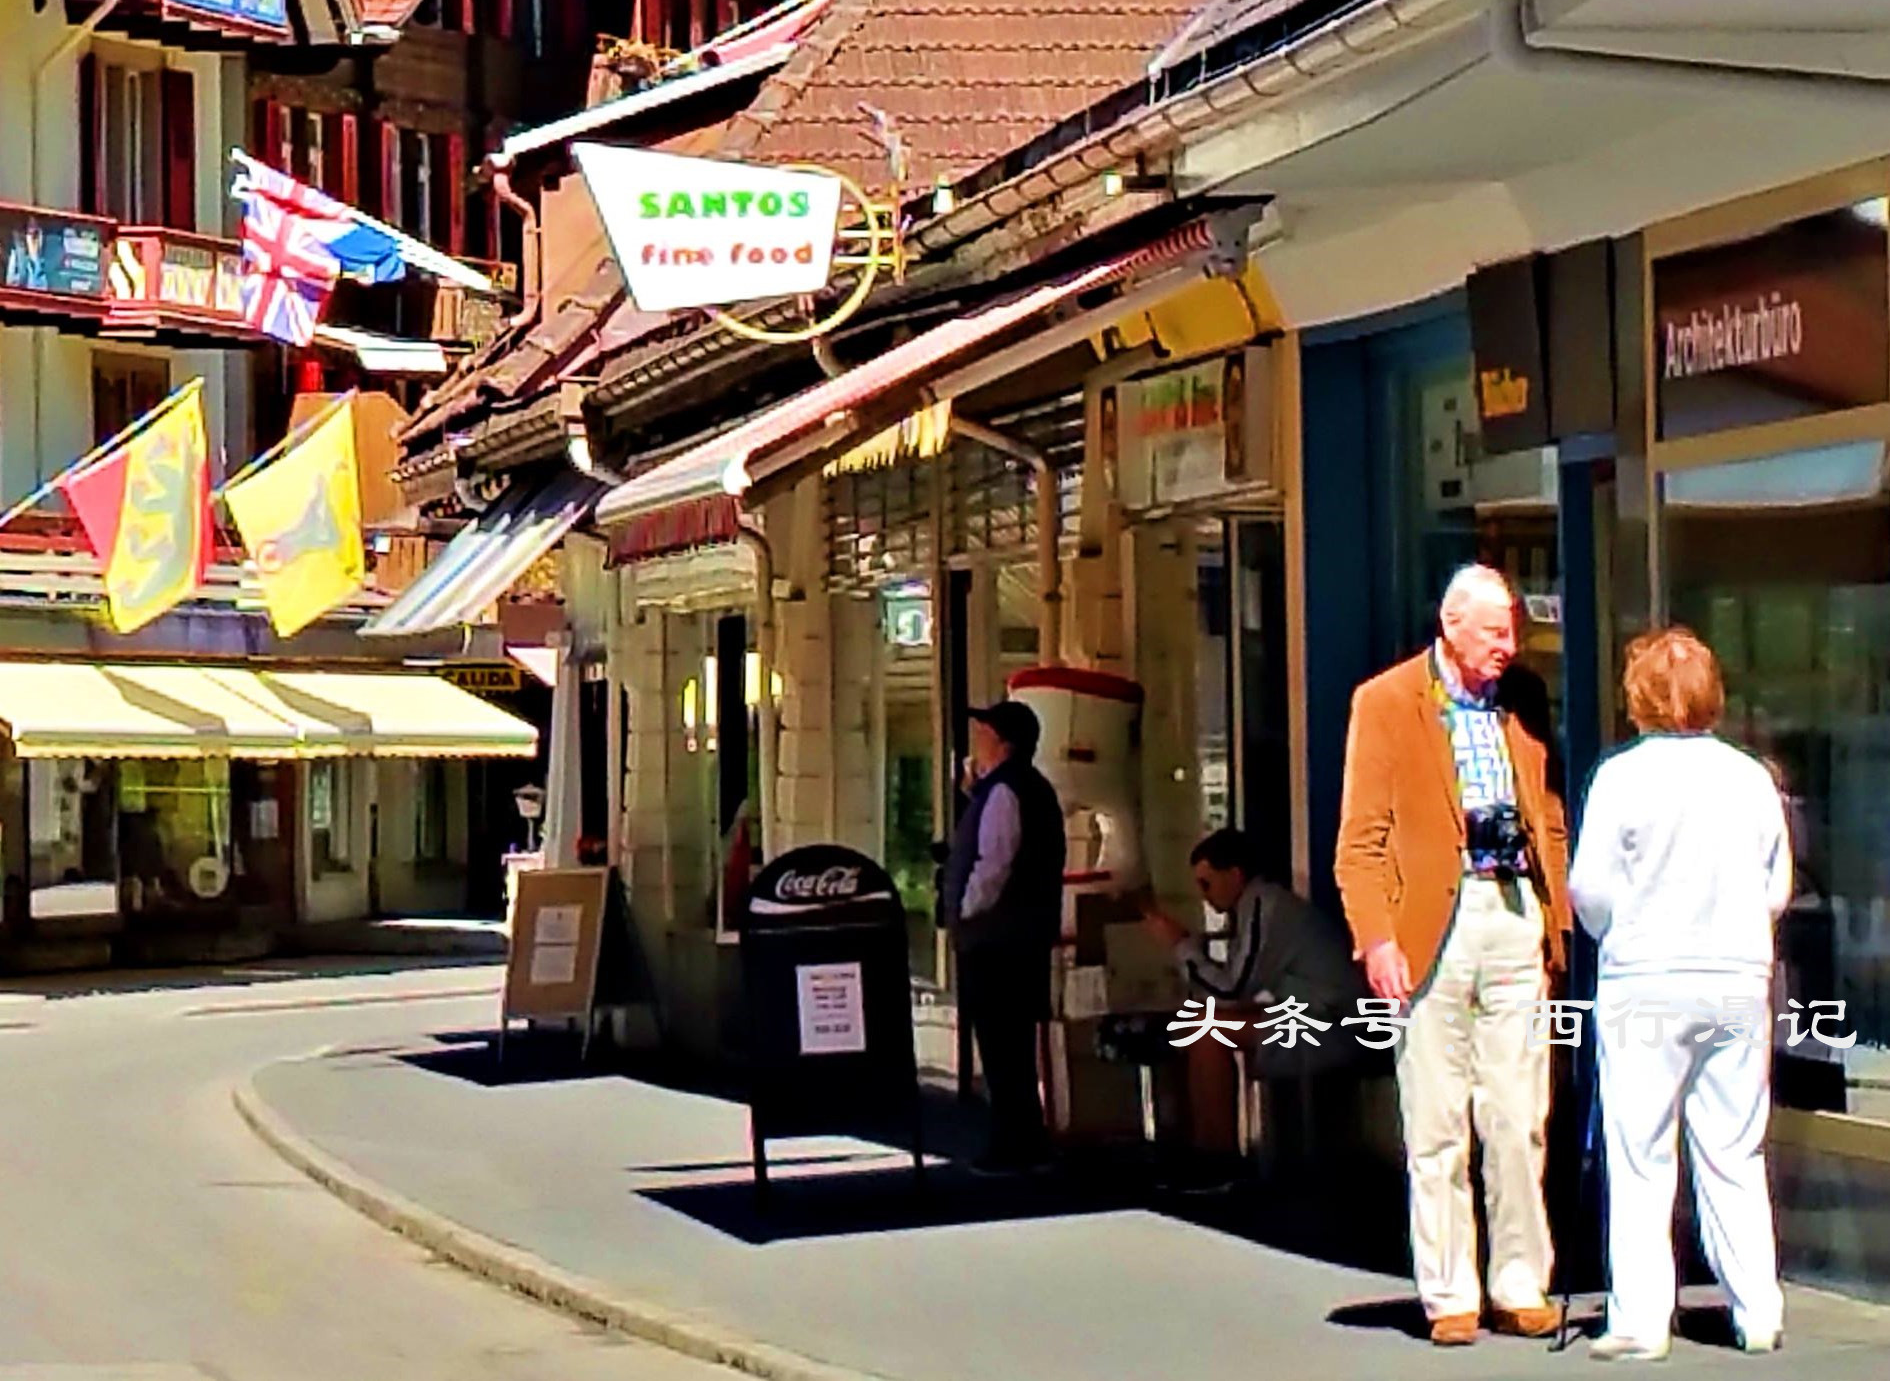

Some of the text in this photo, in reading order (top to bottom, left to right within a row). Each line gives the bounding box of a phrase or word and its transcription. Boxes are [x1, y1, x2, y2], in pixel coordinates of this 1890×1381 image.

[639, 191, 810, 219] SANTOS
[730, 241, 813, 265] food
[1664, 290, 1802, 379] Architekturbüro
